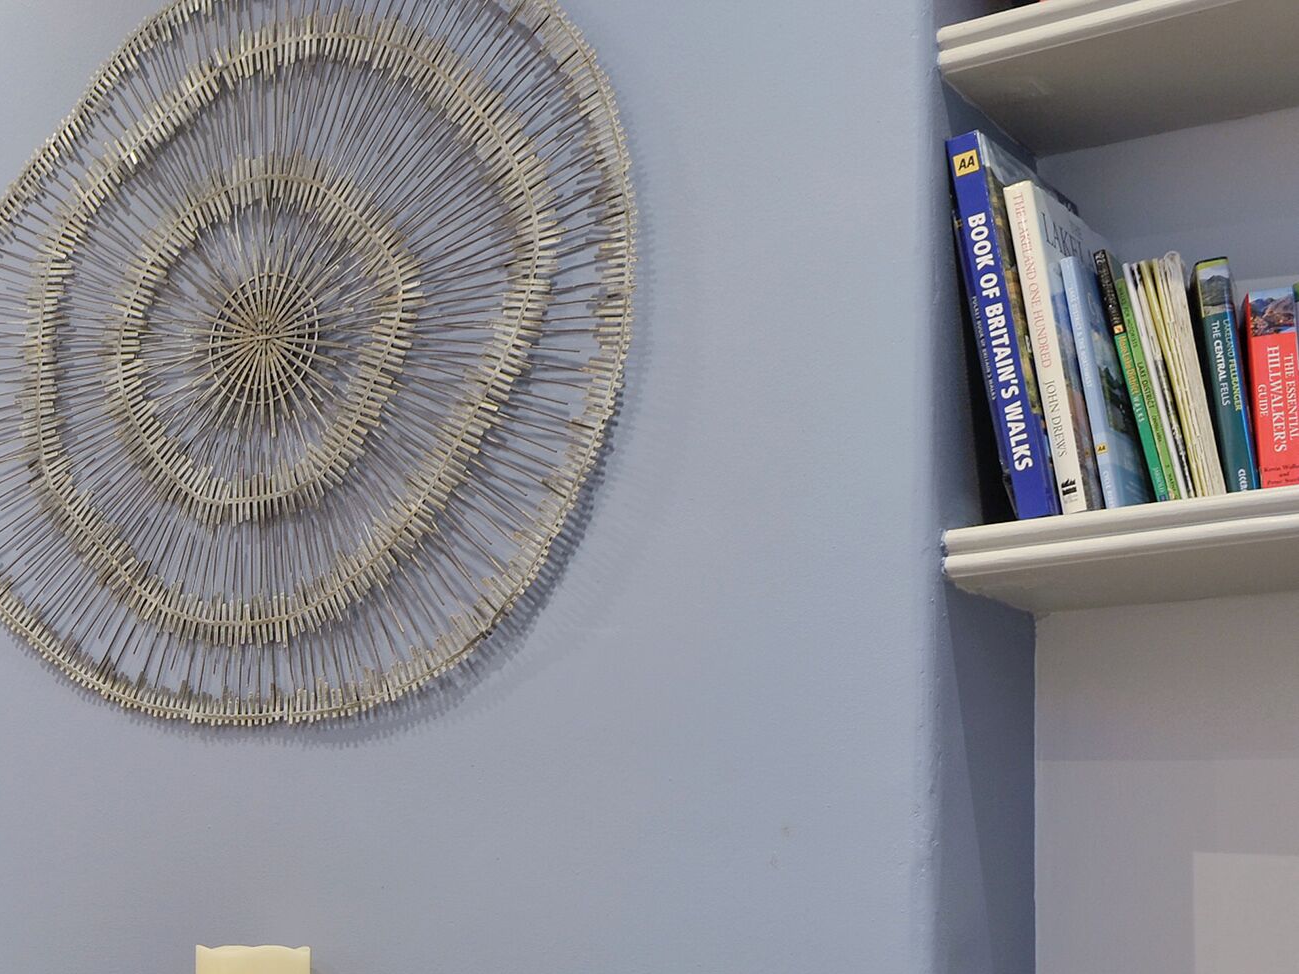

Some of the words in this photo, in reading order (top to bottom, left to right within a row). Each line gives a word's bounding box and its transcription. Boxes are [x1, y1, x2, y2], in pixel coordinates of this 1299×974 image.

[958, 155, 975, 170] AA
[1013, 192, 1027, 216] THE
[967, 212, 995, 271] BOOK
[1017, 216, 1037, 280] LAKELAND
[979, 272, 1001, 299] OF
[1029, 282, 1042, 308] ONE
[1033, 310, 1053, 368] HUNDRED
[1211, 320, 1222, 339] THE
[985, 302, 1020, 399] BRITAIN'S
[1122, 352, 1133, 369] Lake
[1213, 340, 1228, 382] CENTRAL
[1126, 368, 1140, 395] District
[1136, 361, 1146, 377] LAKE
[1284, 353, 1295, 381] THE
[1044, 379, 1060, 413] JOHN
[1140, 379, 1156, 409] DISTRICT
[1220, 382, 1231, 406] FELLS
[1229, 358, 1242, 411] FELLRANGER
[1267, 346, 1287, 452] HILLWALKER'S
[1132, 395, 1145, 422] WALKS
[1257, 384, 1269, 418] GUIDE
[1286, 381, 1299, 441] ESSENTIAL
[1004, 400, 1034, 471] WALKS
[1052, 415, 1068, 458] DREWS
